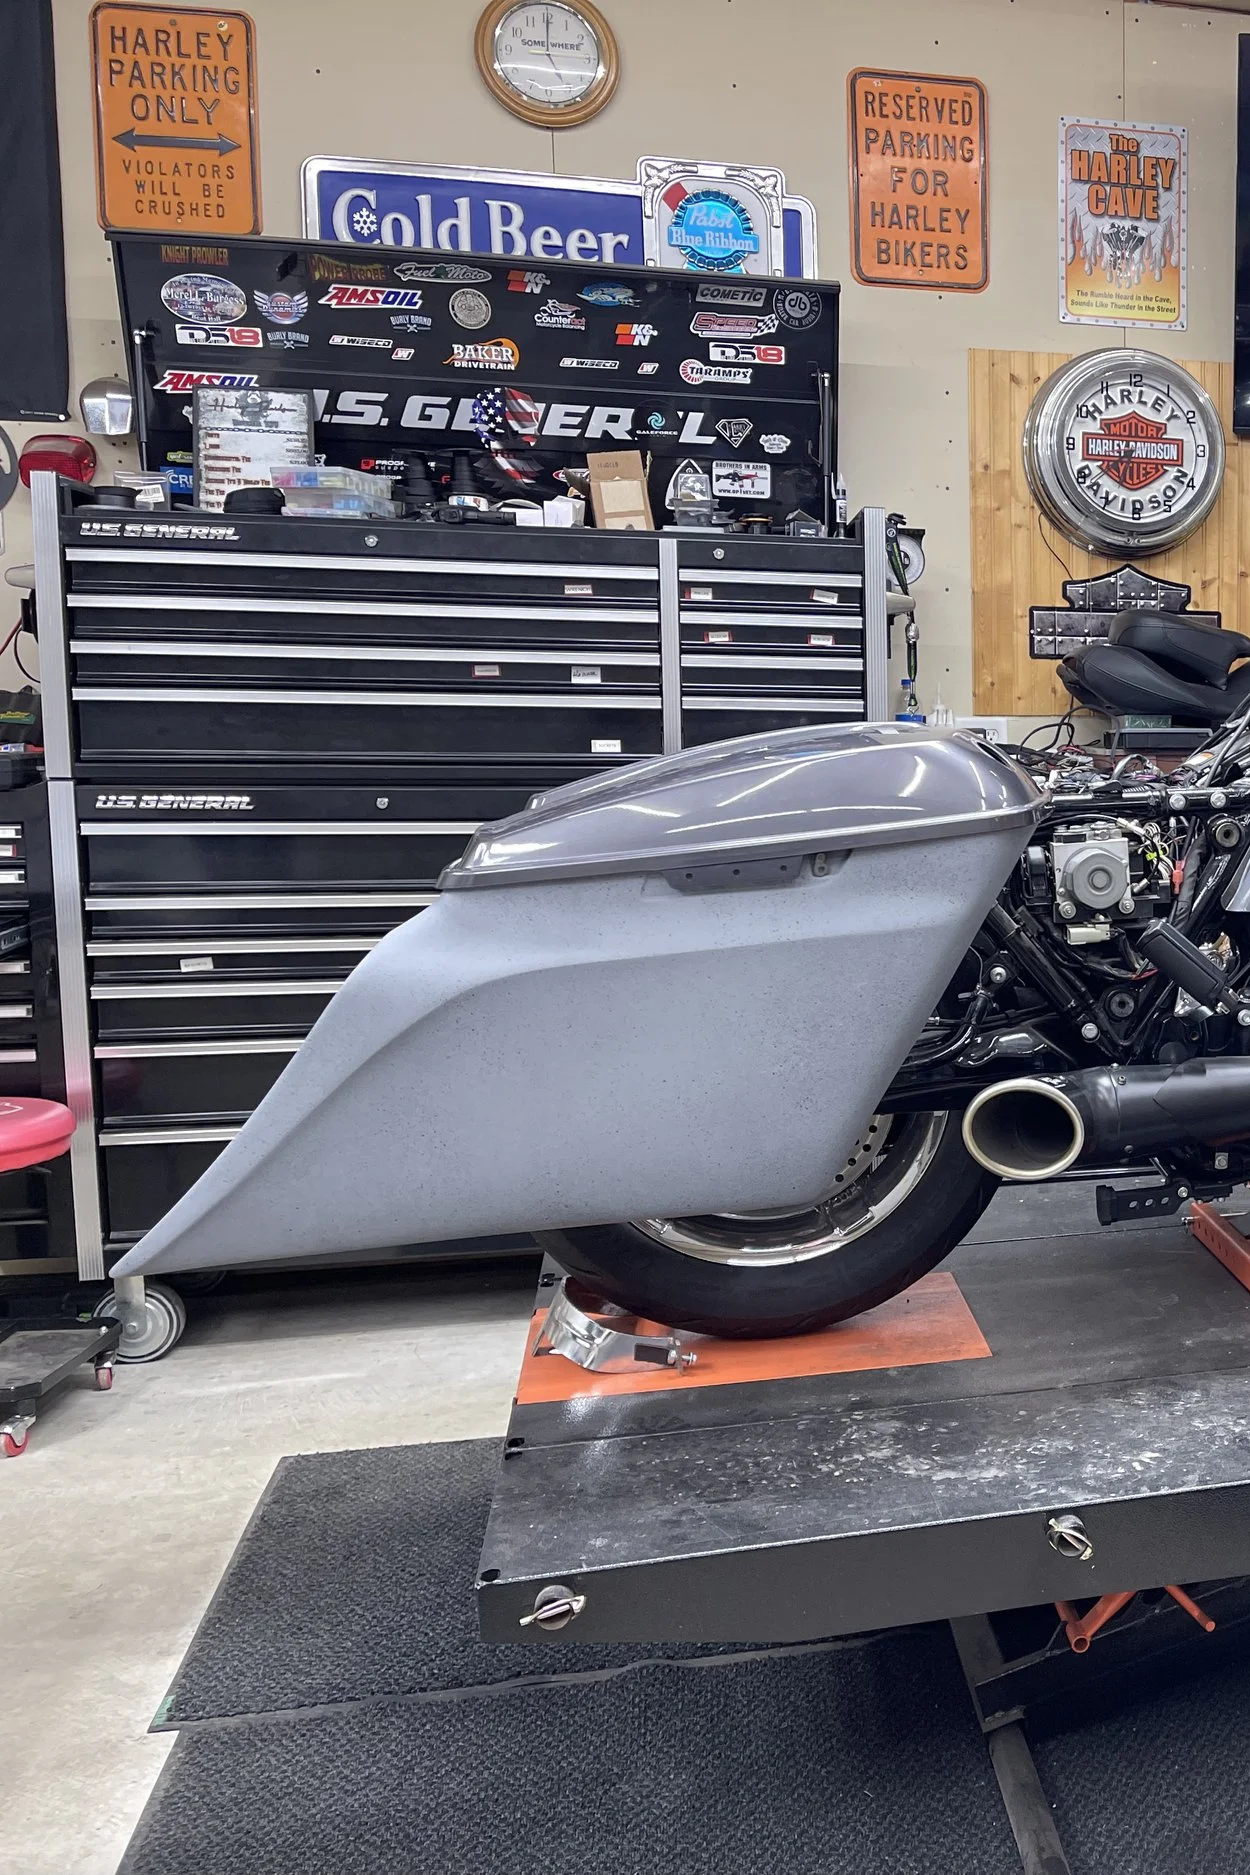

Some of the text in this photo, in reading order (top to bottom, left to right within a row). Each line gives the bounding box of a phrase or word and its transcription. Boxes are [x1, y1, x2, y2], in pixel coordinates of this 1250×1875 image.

[109, 25, 235, 61] HARLEY
[108, 58, 241, 95] PARKING
[131, 94, 220, 126] ONLY
[864, 91, 973, 127] RESERVED
[864, 128, 974, 163] PARKING
[1109, 134, 1139, 152] The
[123, 159, 235, 181] VIOLATORS
[1071, 149, 1175, 189] HARLEY
[134, 179, 225, 199] WILL BE
[891, 167, 949, 197] FOR
[135, 199, 226, 219] CRUSHED
[1087, 183, 1160, 221] CAVE
[332, 187, 630, 264] Cold Beer
[689, 205, 734, 229] Pabst
[870, 201, 970, 234] HARLEY
[671, 228, 754, 251] Blue Ribbon
[160, 244, 229, 266] KNIGHT PROWLER
[876, 238, 969, 270] BIKERS
[402, 265, 485, 281] Fuel Moto
[323, 286, 422, 308] AMSOIL
[700, 288, 763, 302] COMETIC
[1076, 289, 1089, 297] The
[1090, 290, 1114, 299] Rumble
[1115, 292, 1134, 301] Heard
[1155, 295, 1172, 305] Cave,
[1070, 299, 1094, 307] Sounds
[1095, 301, 1109, 309] Like
[1110, 302, 1136, 311] Thunder
[1145, 304, 1155, 312] the
[1157, 305, 1176, 314] Street
[390, 315, 432, 326] BURLY BRAND
[534, 313, 586, 327] Counteract
[267, 331, 309, 343] BURLY BRAND
[452, 344, 514, 362] BAKER
[454, 361, 515, 370] DRIVETRAIN
[689, 366, 749, 378] TARAMPS
[1101, 381, 1170, 398] 11 1
[1129, 374, 1143, 388] 12
[1076, 405, 1088, 418] 10
[1086, 387, 1181, 422] HARLEY
[1186, 411, 1196, 424] 2
[1109, 422, 1160, 437] MOTOR
[1066, 437, 1075, 450] 9
[1196, 445, 1206, 458] 3
[715, 462, 742, 470] BROTHERS
[1076, 471, 1086, 484] 8
[1186, 478, 1195, 491] 4
[1076, 463, 1189, 512] DAVIDSON
[1131, 507, 1141, 520] 6
[1163, 500, 1172, 513] 5
